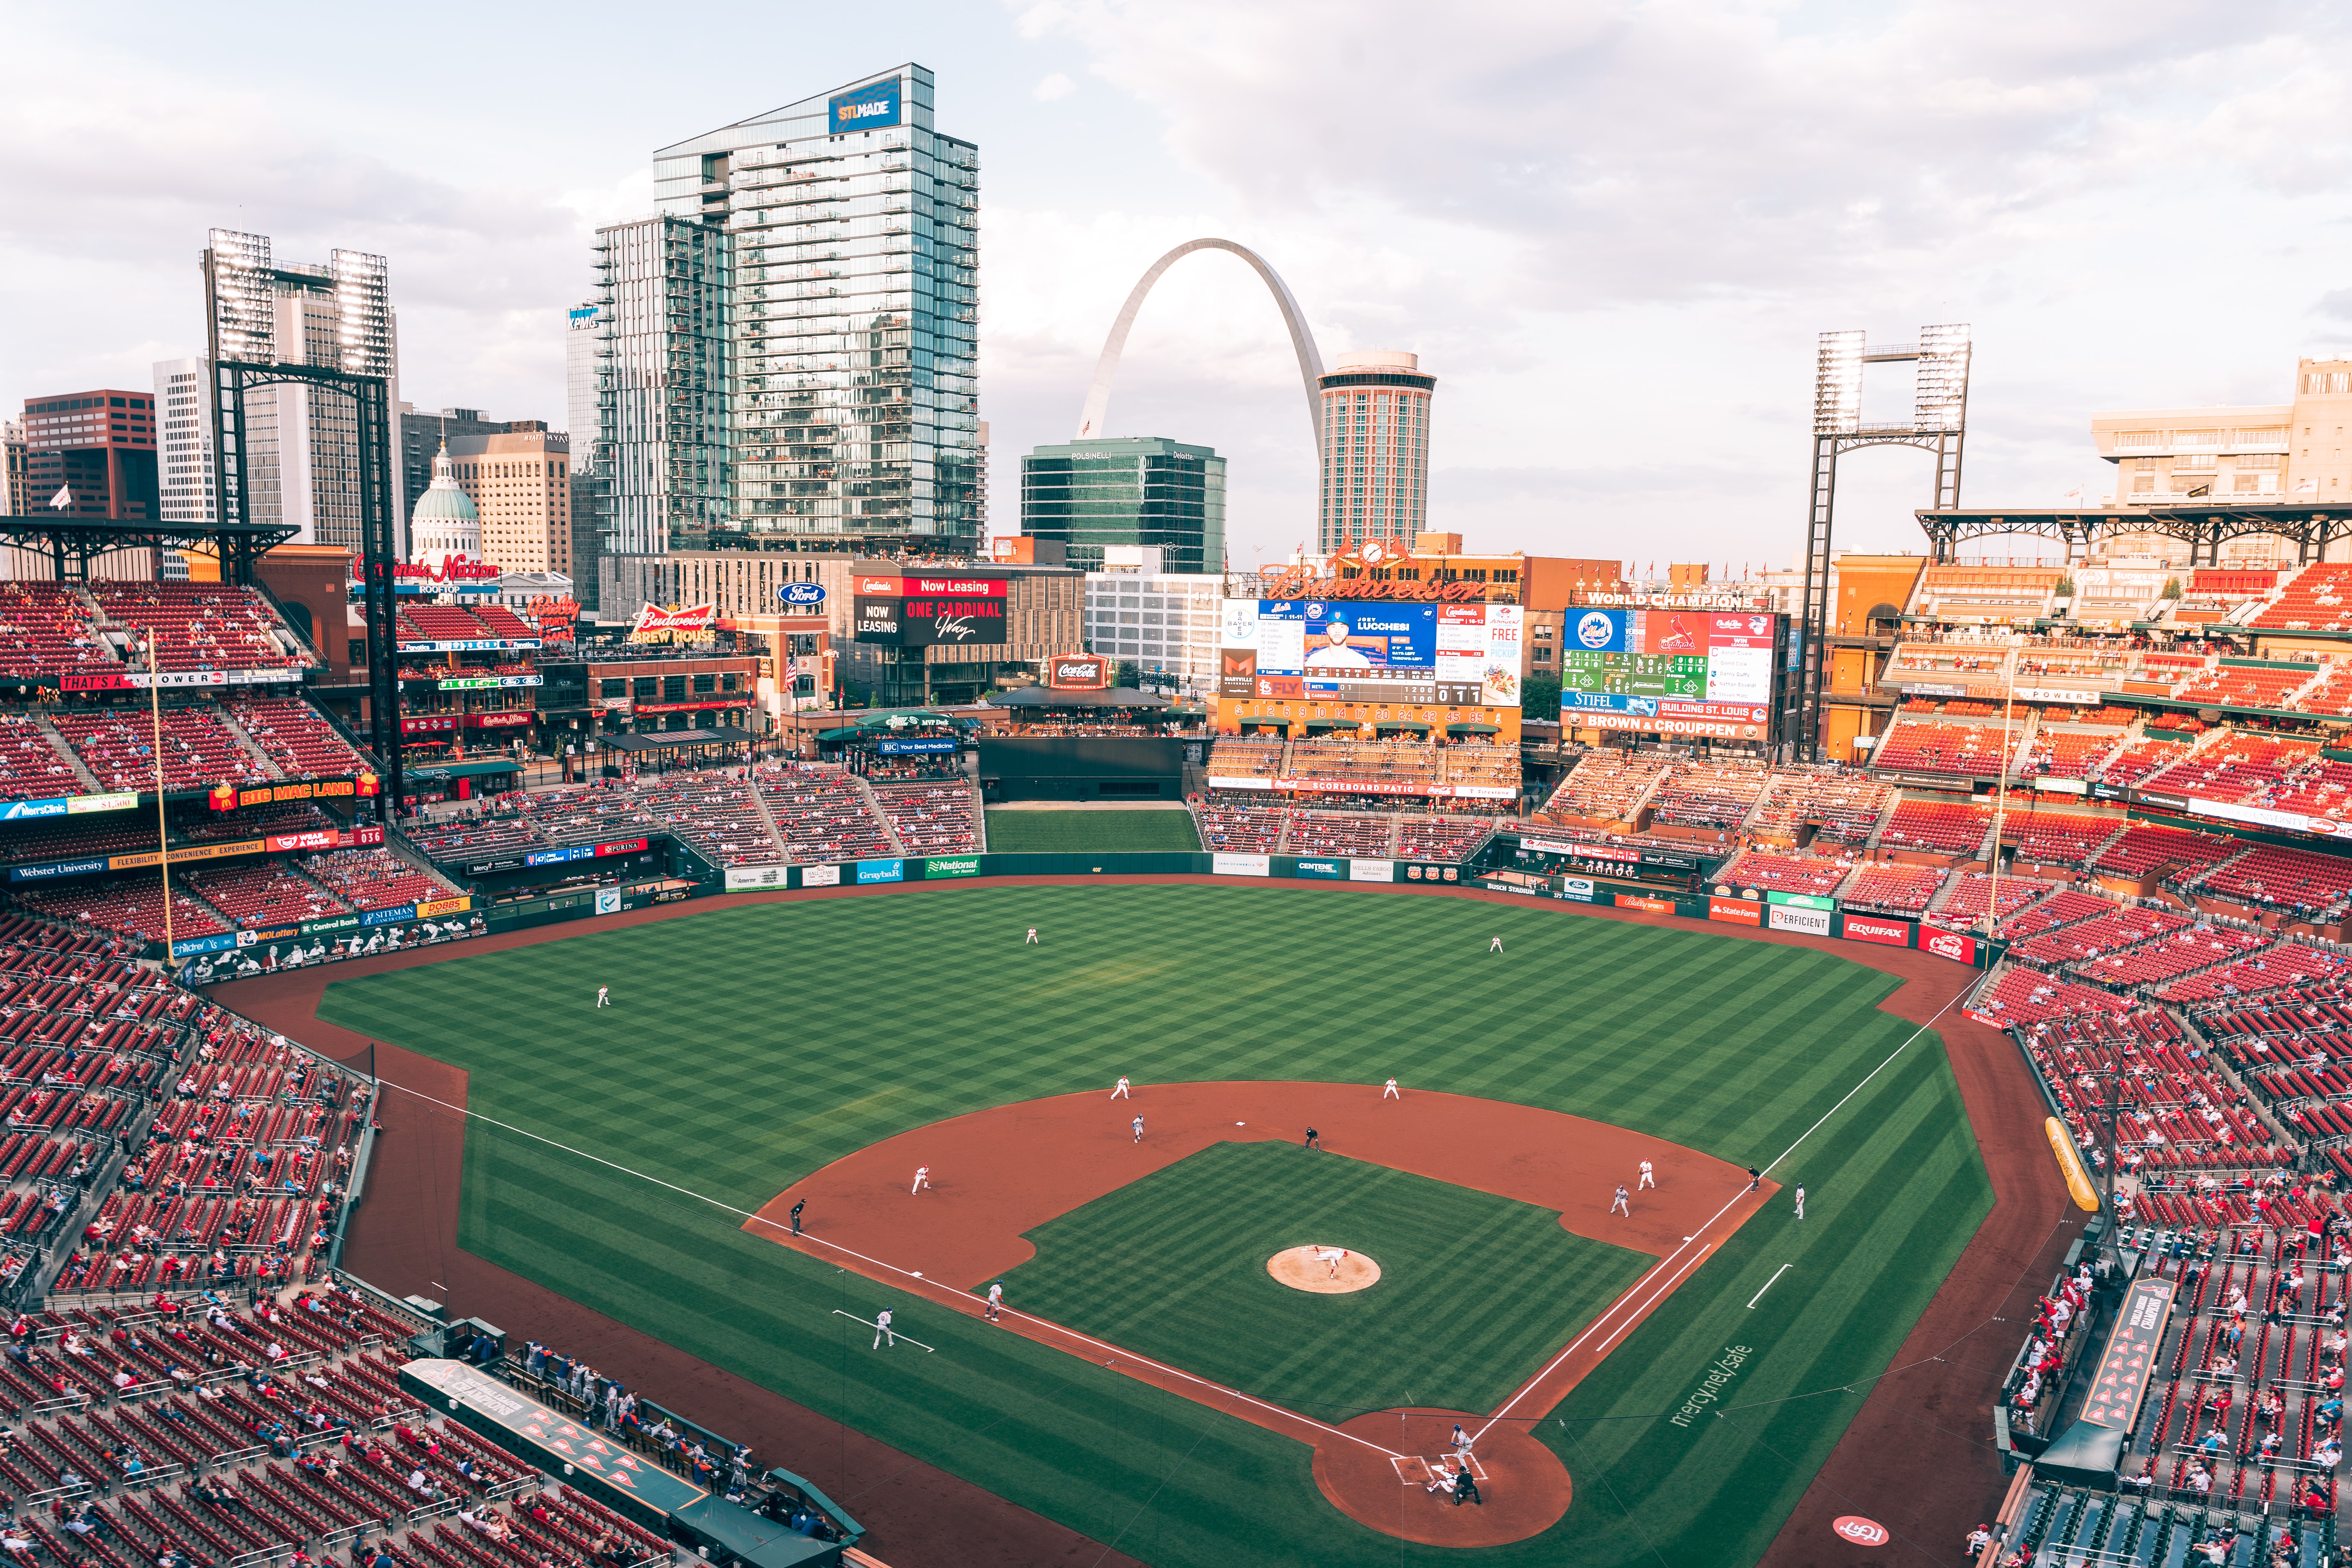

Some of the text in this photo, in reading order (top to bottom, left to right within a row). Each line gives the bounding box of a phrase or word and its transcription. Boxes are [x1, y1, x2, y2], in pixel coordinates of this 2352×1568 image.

[839, 100, 890, 120] STLMADE
[568, 316, 596, 331] KPMG
[434, 554, 498, 583] Nation
[1260, 564, 1486, 601] Budweiser
[2114, 572, 2169, 580] BUDWEISER
[863, 578, 891, 592] Cardinals
[922, 580, 988, 595] Now Leasing
[789, 585, 819, 601] Ford
[1587, 592, 1754, 608] WORLD CHAMPIONS
[527, 594, 581, 621] Bally
[867, 606, 888, 617] NOW
[907, 602, 1001, 617] ONE CARDINAL
[1271, 602, 1291, 613] Mets
[1446, 606, 1478, 617] Cardinals
[539, 617, 568, 626] SPORTS
[632, 611, 715, 629] Budweiser
[858, 620, 897, 633] LEASING
[935, 611, 975, 640] Way
[1358, 623, 1409, 631] LUCCHESI
[538, 626, 574, 643] Live!
[633, 630, 715, 643] BREW HOUSE
[1492, 629, 1517, 640] FREE
[1491, 649, 1517, 658] PICKUP
[1058, 664, 1098, 677] Coca-Cola
[64, 677, 121, 690] THAT'S A
[1274, 683, 1299, 694] FLY
[1968, 686, 2002, 697] THAT'S
[1575, 692, 1613, 707] STIFEL
[1255, 705, 1484, 723] 1 2 6 9 10 14 17 20 24 42 45 85
[1661, 703, 1749, 716] BUILDING ST. LOUIS
[1588, 715, 1737, 736] BROWN & CROUPPEN
[240, 782, 354, 806] BIG MAC LAND
[1312, 782, 1414, 793] SCOREBOARD PATIO
[2193, 803, 2304, 826] LINDENWOOD UNIVERSITY
[308, 837, 330, 846] MASK
[612, 843, 637, 851] PURINA
[118, 843, 259, 866] FLEXIBILITY CONVENIENCE EXPERIENCE
[19, 861, 103, 878] Webster University
[939, 860, 977, 870] National
[596, 888, 619, 897] CarShield
[1487, 883, 1535, 895] BUSCH STADIUM
[429, 900, 460, 911] DOBBS
[1625, 897, 1648, 910] Bally
[376, 907, 413, 918] SITEMAN
[1772, 910, 1826, 928] PERFICIENT
[313, 917, 359, 930] Central Bank
[258, 928, 299, 941] MOLottery
[1848, 923, 1903, 938] EQUIFAX
[1930, 937, 1962, 956] Club
[1929, 948, 1961, 961] CARWASH
[2130, 1309, 2143, 1326] WORLD
[2141, 1298, 2162, 1330] CHAMPIONS
[1669, 1344, 1753, 1427] mercy.net/safe
[451, 1381, 516, 1416] CHAMPIONS
[527, 1426, 540, 1434] 1930
[561, 1426, 574, 1435] 1943
[620, 1457, 633, 1467] 2004
